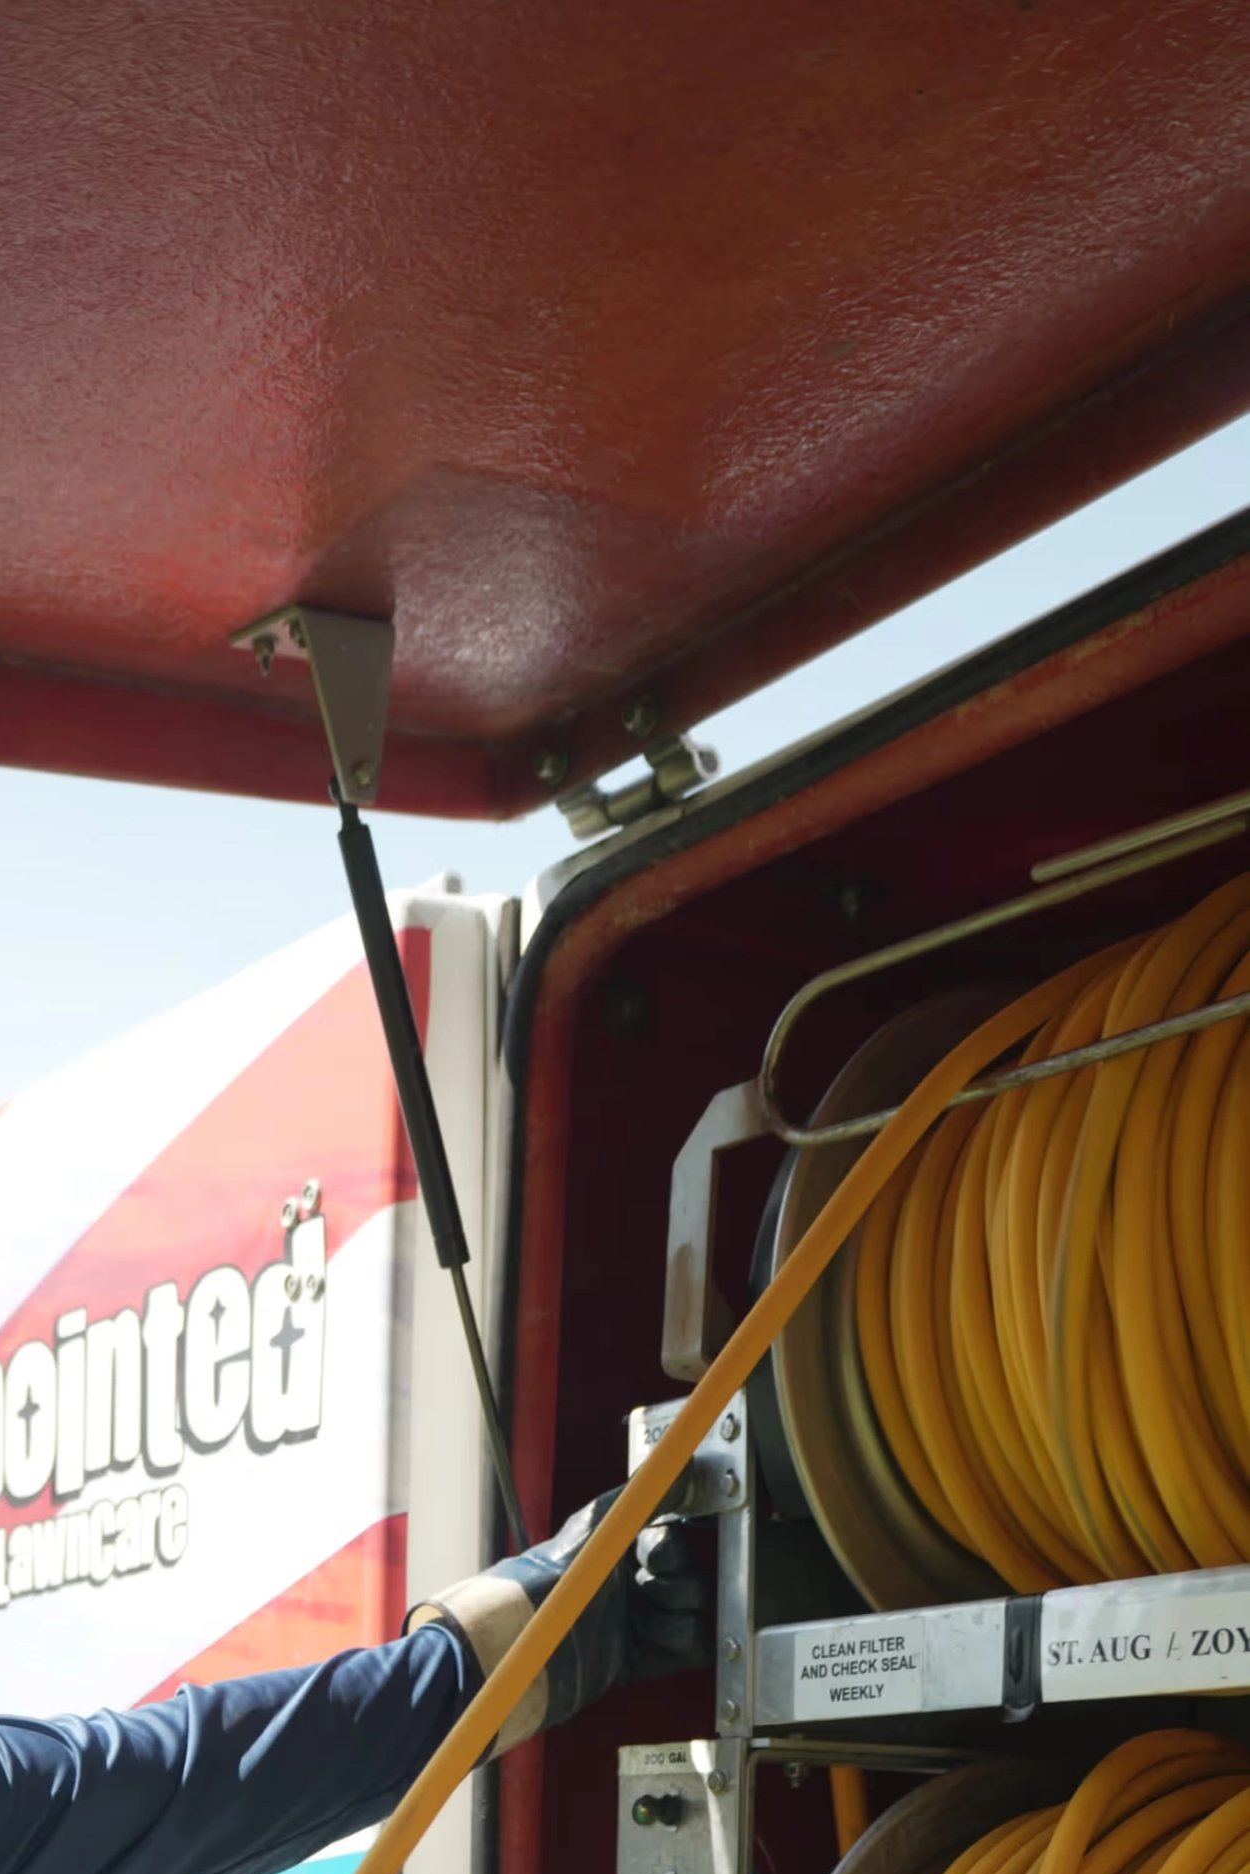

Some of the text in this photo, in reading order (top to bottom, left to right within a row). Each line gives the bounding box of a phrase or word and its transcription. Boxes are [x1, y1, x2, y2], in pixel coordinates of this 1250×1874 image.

[812, 1636, 905, 1660] CLEAN FILTER
[1048, 1639, 1083, 1666] ST.
[1090, 1634, 1151, 1663] AUG
[801, 1655, 917, 1680] AND CHECK SEAL
[829, 1683, 884, 1702] WEEKLY
[668, 1751, 686, 1764] GAL
